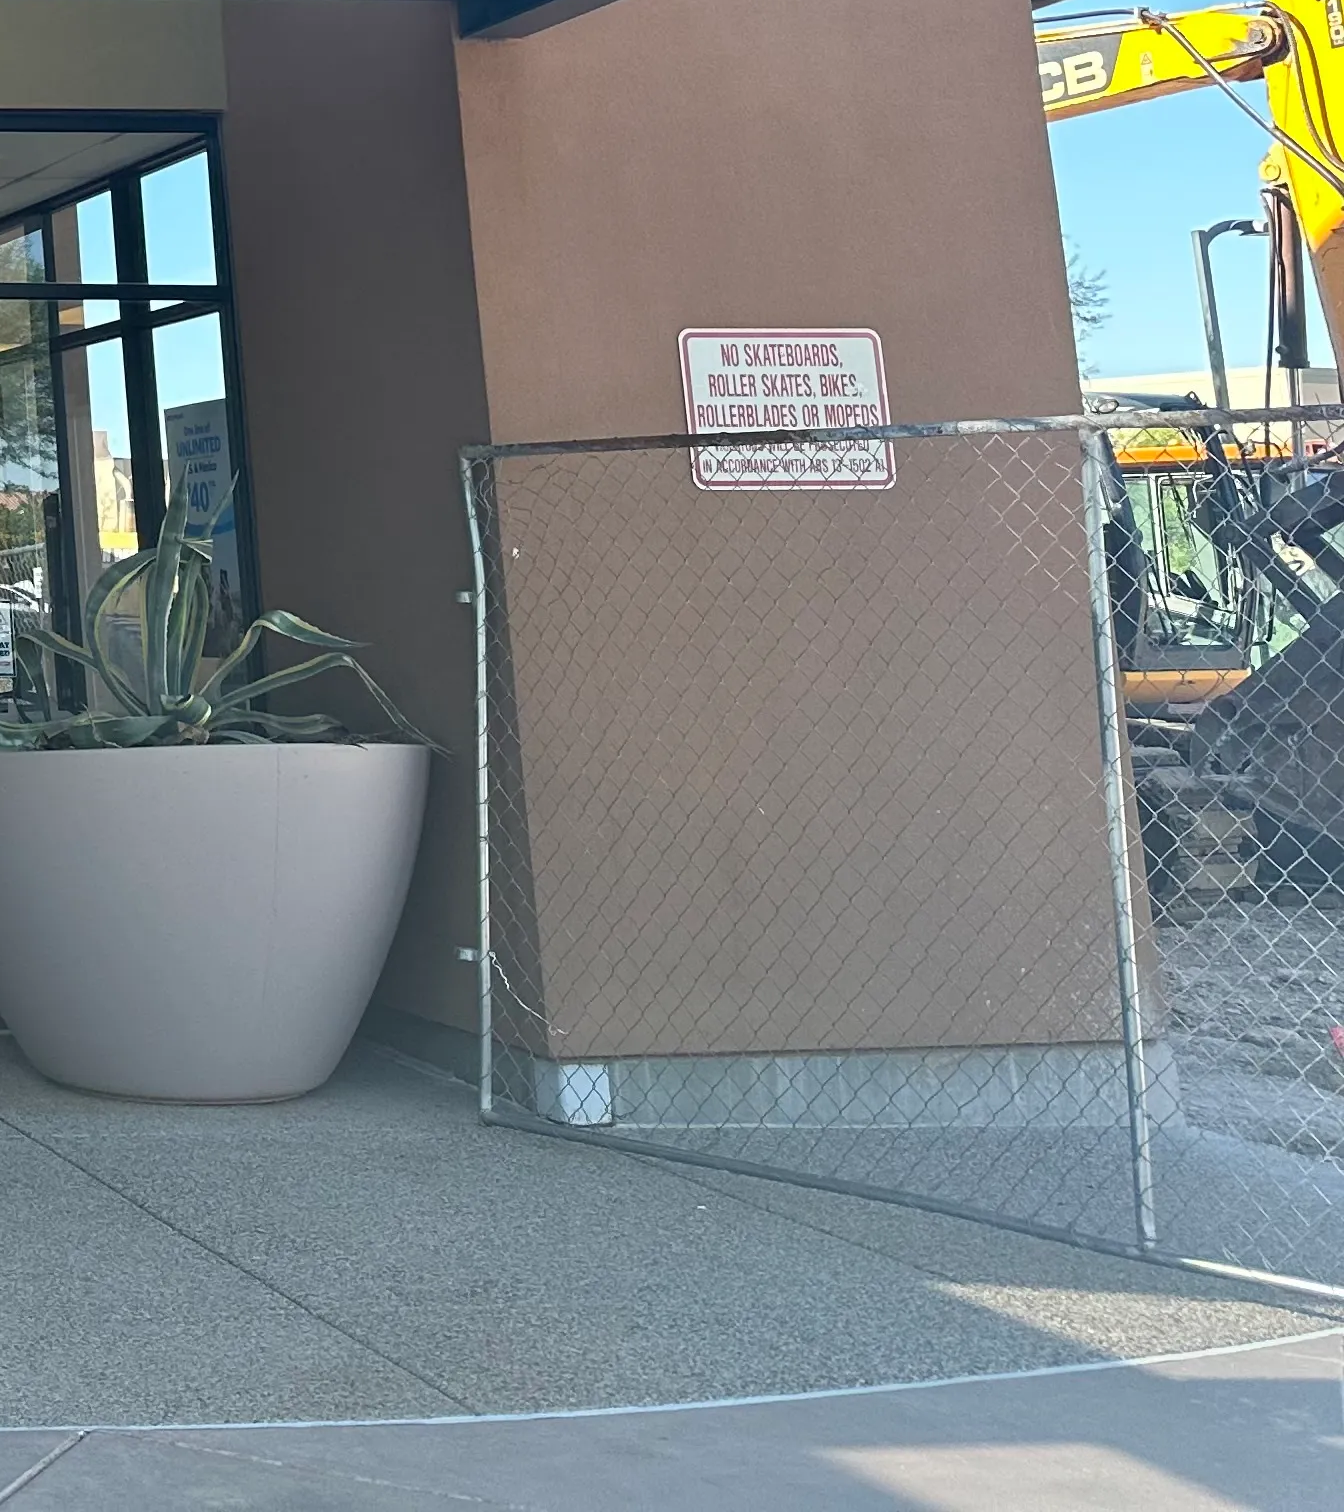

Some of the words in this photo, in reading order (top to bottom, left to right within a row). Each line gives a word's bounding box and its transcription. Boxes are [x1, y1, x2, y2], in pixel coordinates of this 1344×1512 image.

[720, 343, 741, 367] NO
[743, 343, 844, 369] SKATEBOARDS,
[708, 373, 757, 398] ROLLER
[760, 373, 816, 400] SKATES,
[697, 403, 798, 428] ROLLERBLADES
[802, 403, 820, 428] OR
[823, 403, 880, 427] MOPEDS
[177, 435, 222, 457] UNLIMITED
[702, 459, 713, 473] IN
[717, 459, 778, 474] ACCORDANCE
[781, 459, 806, 473] WITH
